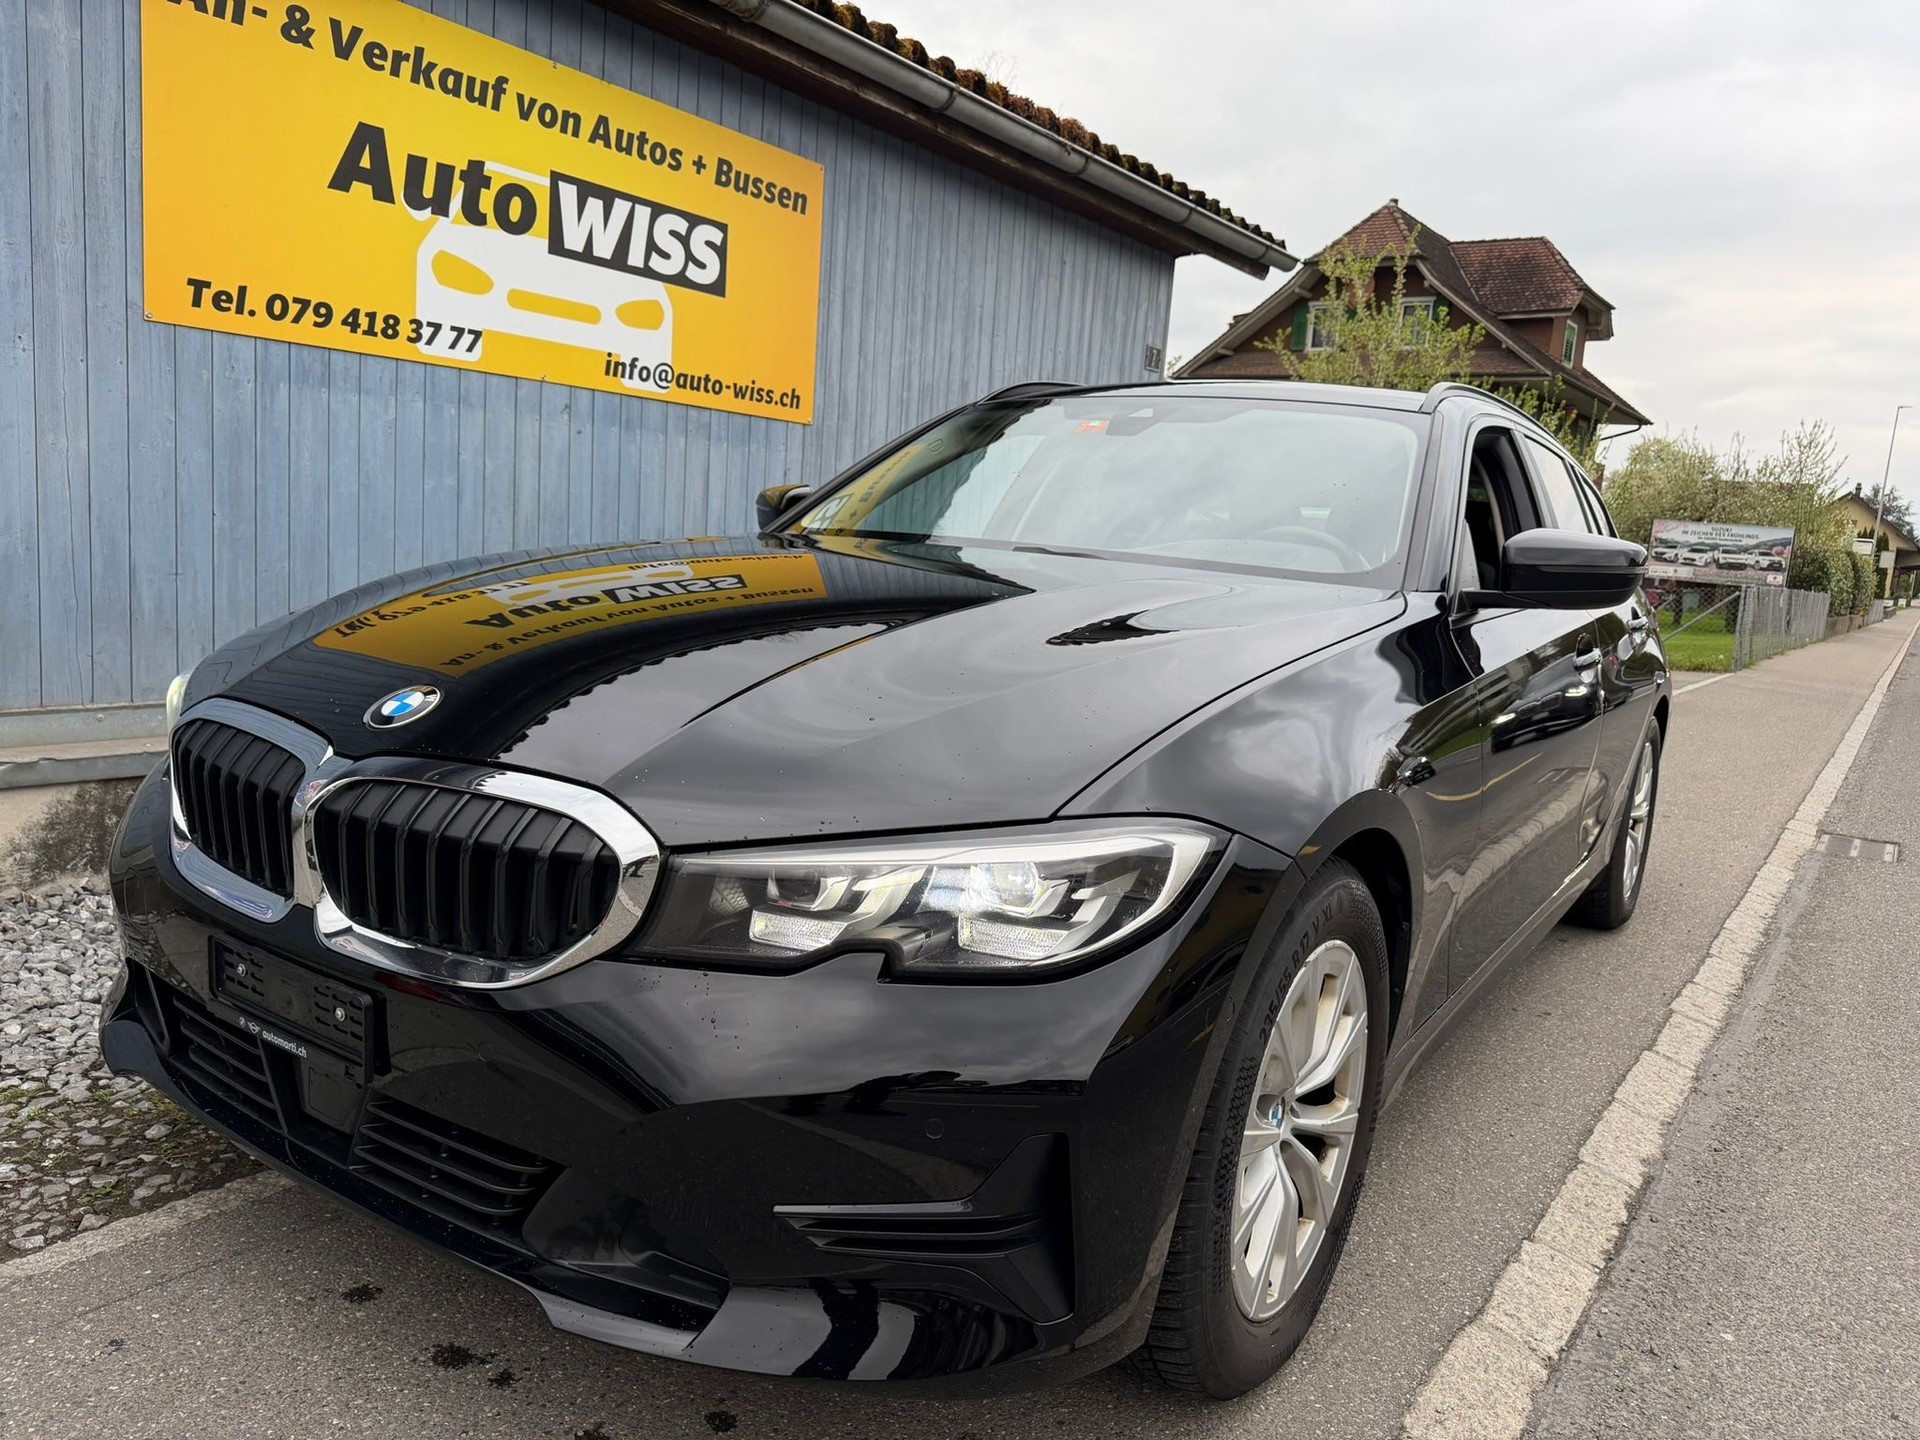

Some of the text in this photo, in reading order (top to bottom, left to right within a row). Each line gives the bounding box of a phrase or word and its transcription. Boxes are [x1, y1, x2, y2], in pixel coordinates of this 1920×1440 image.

[280, 4, 315, 50] &
[329, 17, 507, 112] Verkauf
[516, 92, 582, 138] von
[588, 114, 683, 171] Autos
[692, 155, 707, 175] +
[714, 157, 808, 215] Bussen
[327, 121, 724, 285] Auto WISS
[187, 278, 483, 353] Tel. 079 418 37 77
[604, 352, 801, 410] info@auto-wiss.ch
[262, 1030, 307, 1058] automarti.ch
